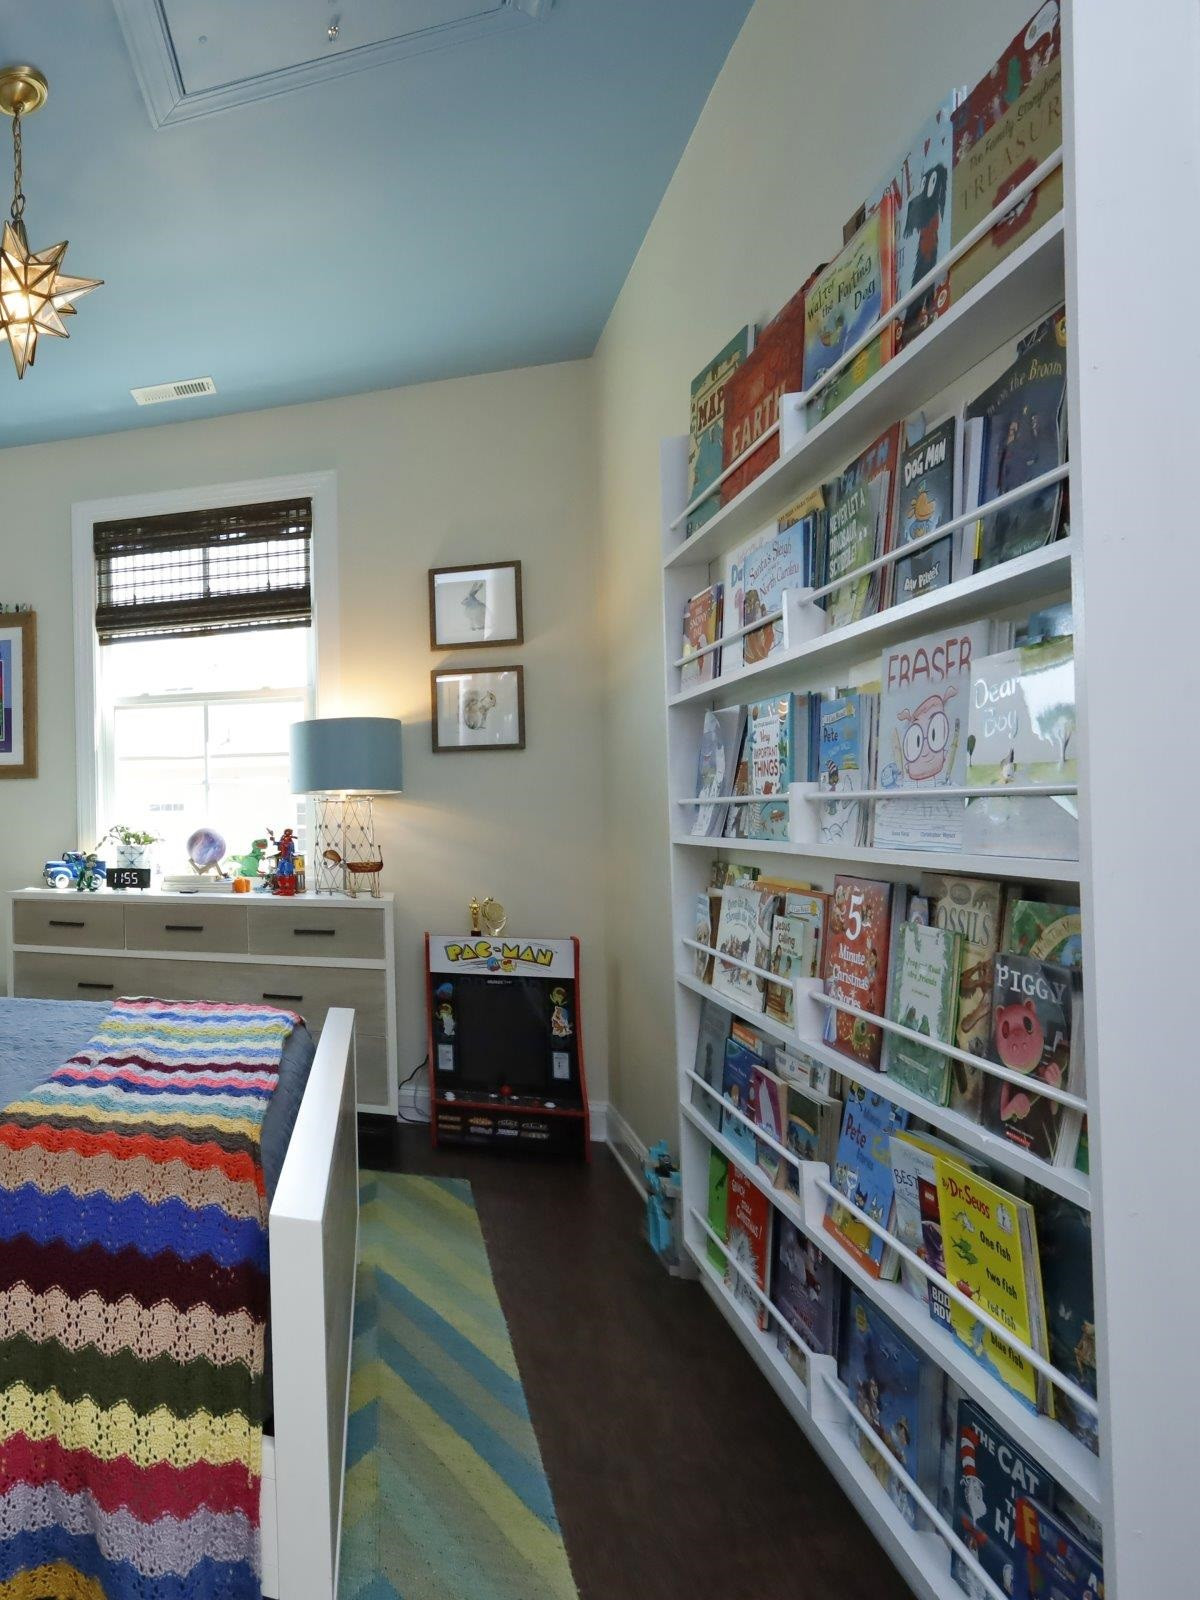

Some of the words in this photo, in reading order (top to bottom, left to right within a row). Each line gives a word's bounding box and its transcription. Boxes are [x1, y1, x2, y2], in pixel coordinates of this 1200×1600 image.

[985, 120, 1014, 153] Family
[1017, 71, 1061, 122] Storyboo
[961, 95, 1061, 210] TREASUR
[808, 278, 834, 321] Walter
[822, 301, 834, 318] the
[838, 254, 872, 303] Farting
[854, 279, 875, 311] Dog
[1009, 370, 1026, 392] the
[1028, 358, 1063, 381] Broom
[698, 384, 725, 432] MAP
[904, 453, 924, 487] DOG
[924, 437, 947, 471] MAN
[974, 676, 1020, 710] Dear
[823, 727, 839, 743] Pete
[754, 759, 778, 777] THINGS
[845, 894, 864, 941] 5
[937, 904, 992, 947] OSSILS
[445, 940, 553, 967] PAC-MAN
[839, 942, 866, 967] Minute
[832, 963, 870, 990] Christmas
[996, 963, 1066, 1004] PIGGY
[845, 1113, 866, 1149] Pete
[894, 1168, 919, 1190] BEST
[948, 1178, 964, 1200] Dr.
[964, 1184, 991, 1220] Seuss
[979, 1230, 994, 1250] One
[995, 1240, 1011, 1263] fish
[932, 1285, 950, 1309] BOO
[986, 1267, 1001, 1286] two
[1001, 1276, 1017, 1300] fish
[933, 1301, 952, 1324] ADV
[987, 1300, 999, 1318] red
[999, 1306, 1017, 1332] fish
[990, 1330, 1007, 1355] blue
[1008, 1348, 1024, 1371] fish
[972, 1421, 996, 1457] THE
[998, 1445, 1040, 1495] CAT
